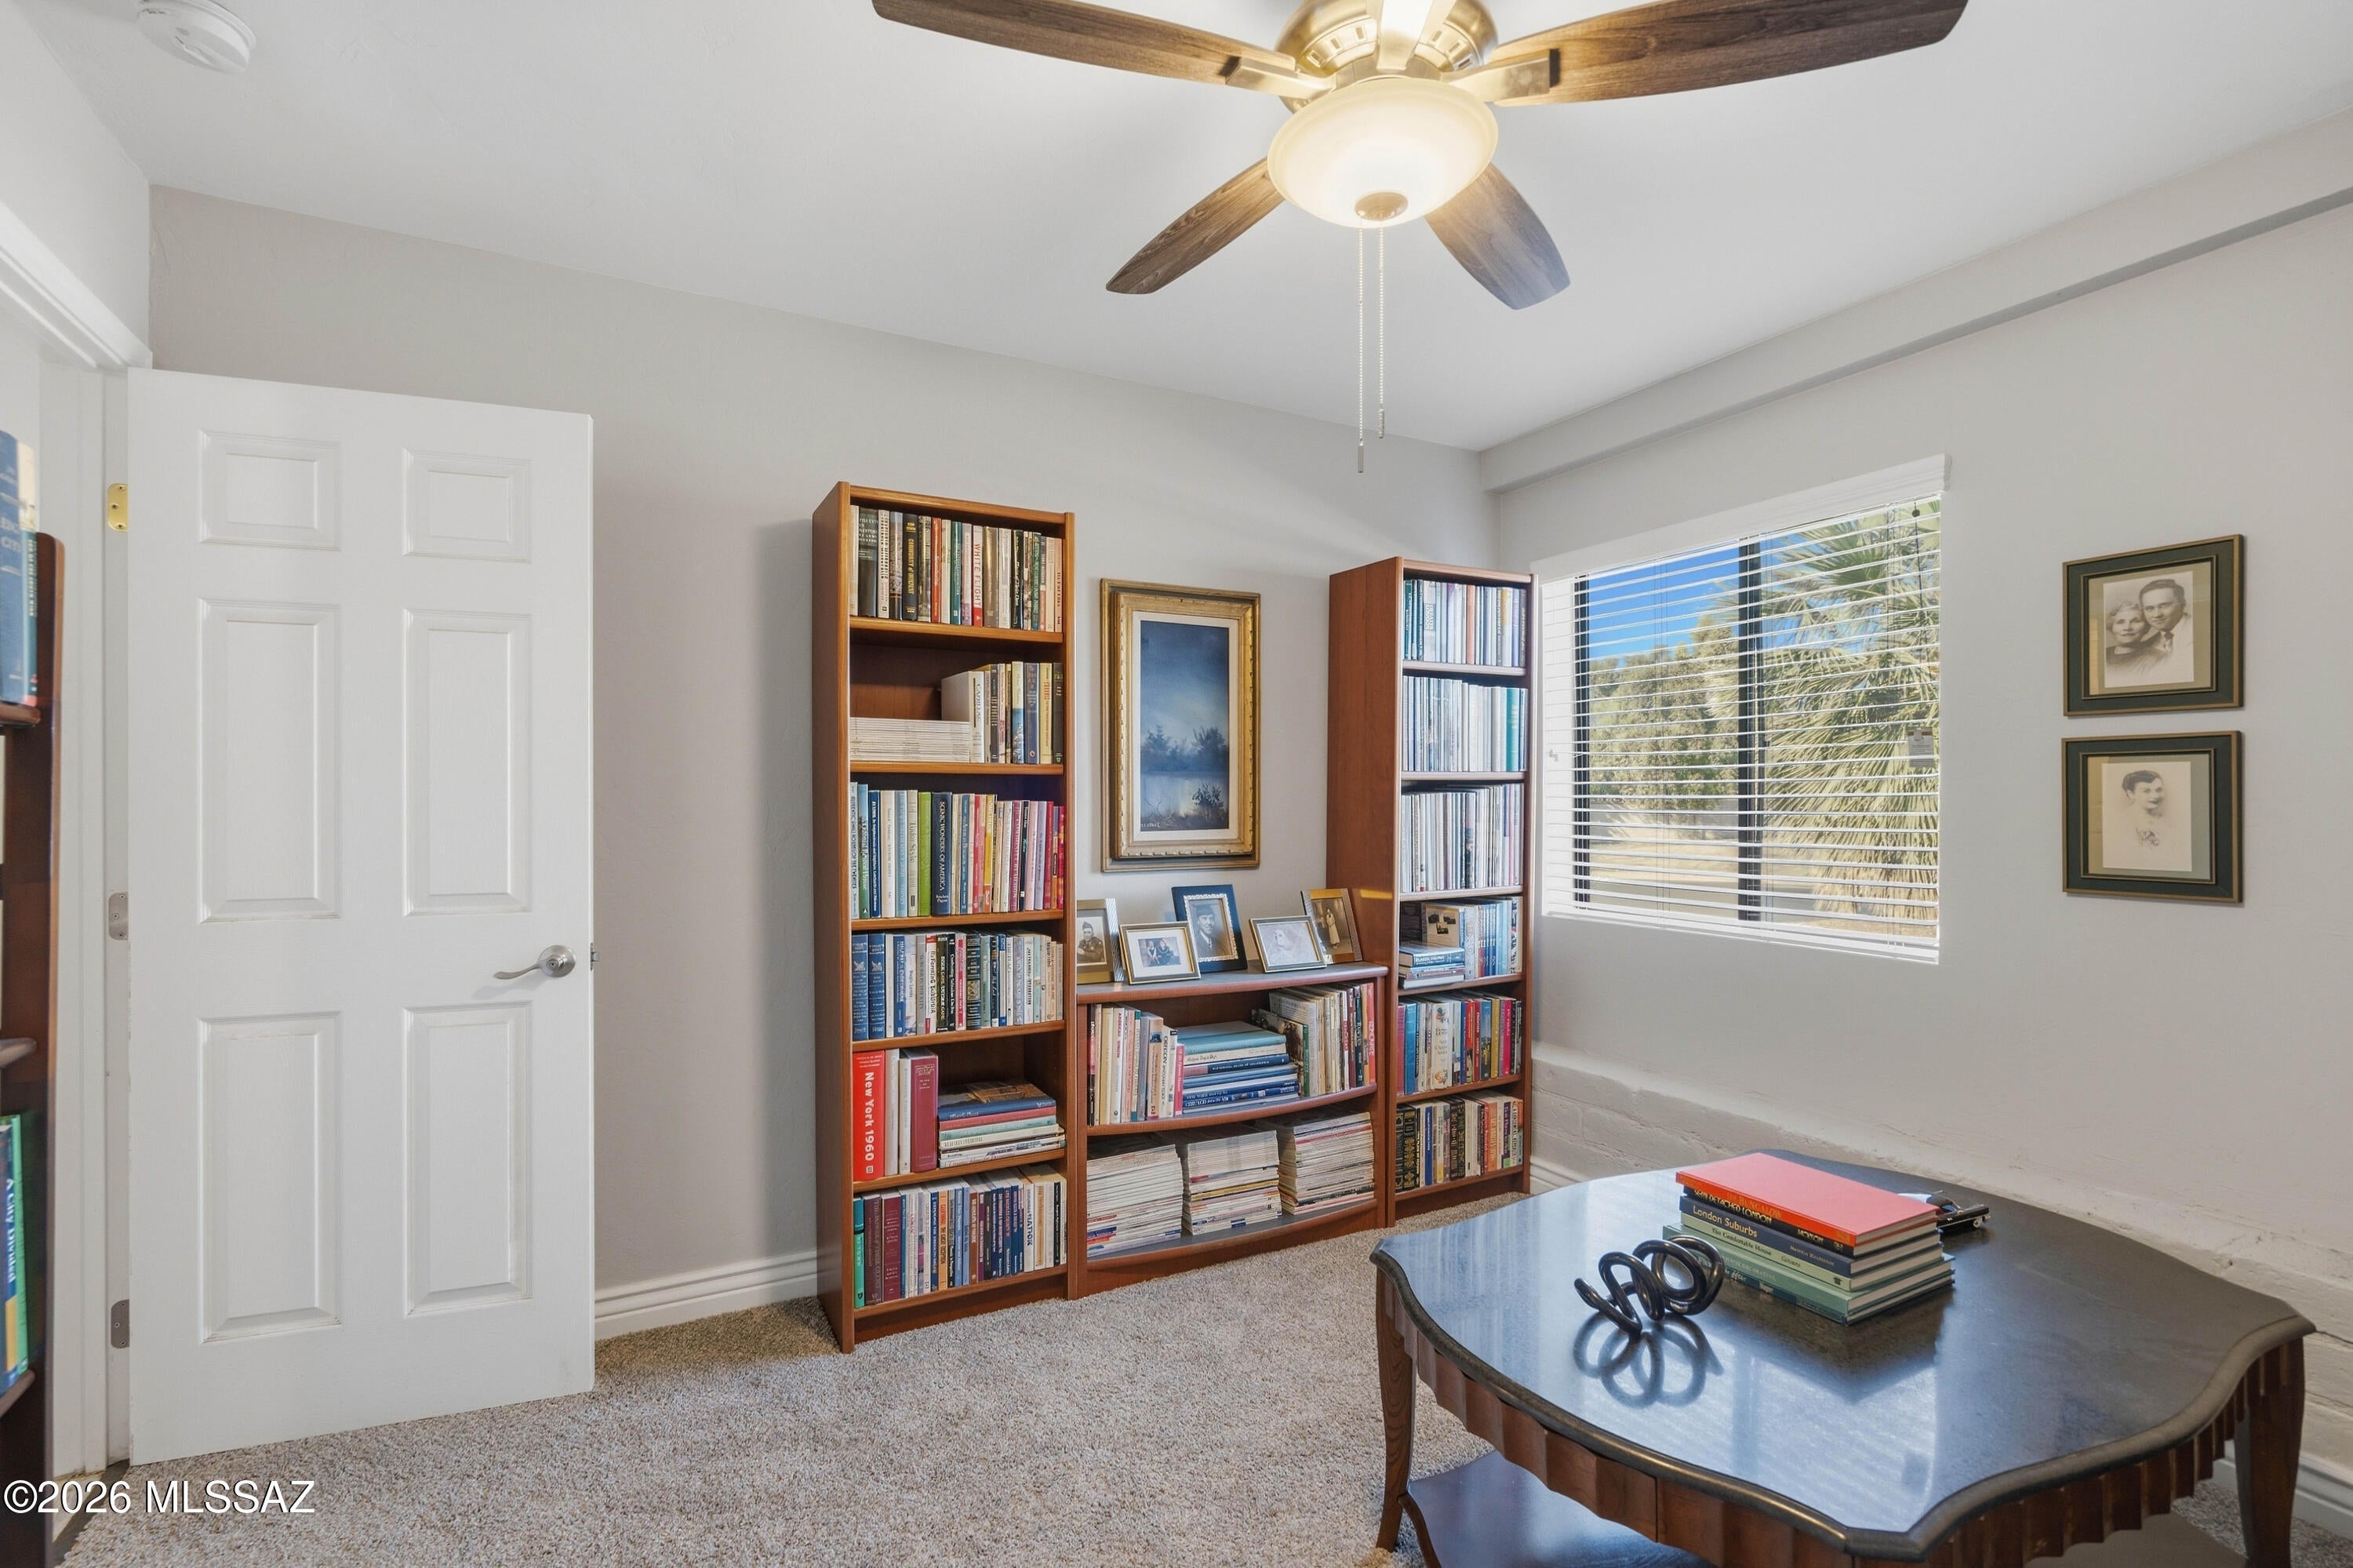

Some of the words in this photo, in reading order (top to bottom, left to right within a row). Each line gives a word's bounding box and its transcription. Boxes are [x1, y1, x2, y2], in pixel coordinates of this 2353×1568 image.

[864, 1071, 875, 1097] New
[864, 1098, 875, 1127] York
[864, 1129, 875, 1161] 1960
[5, 1192, 16, 1225] City
[1693, 1204, 1722, 1226] London
[1724, 1217, 1758, 1239] Suburbs
[1742, 1206, 1773, 1225] LONDON
[7, 1226, 16, 1283] Divided
